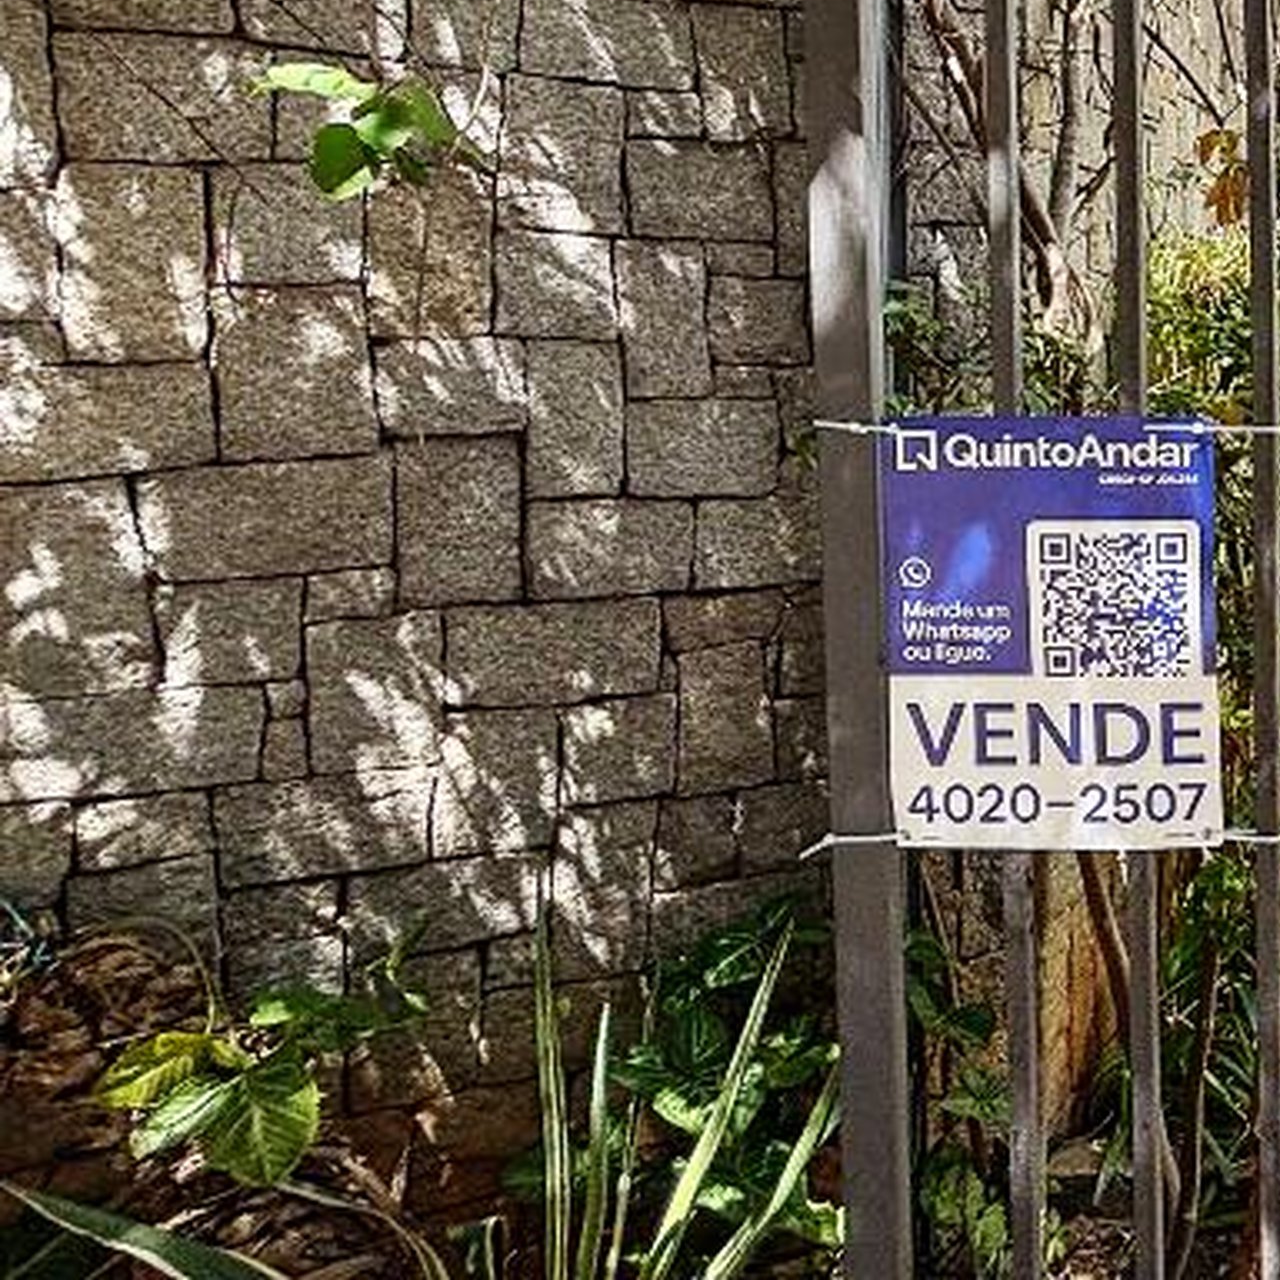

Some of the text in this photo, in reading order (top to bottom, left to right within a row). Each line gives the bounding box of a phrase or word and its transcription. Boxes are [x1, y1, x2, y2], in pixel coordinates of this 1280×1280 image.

[943, 433, 1200, 470] QuintoAndar
[902, 645, 931, 661] ou
[905, 702, 1207, 767] VENDE
[908, 782, 1208, 825] 4020-2507
